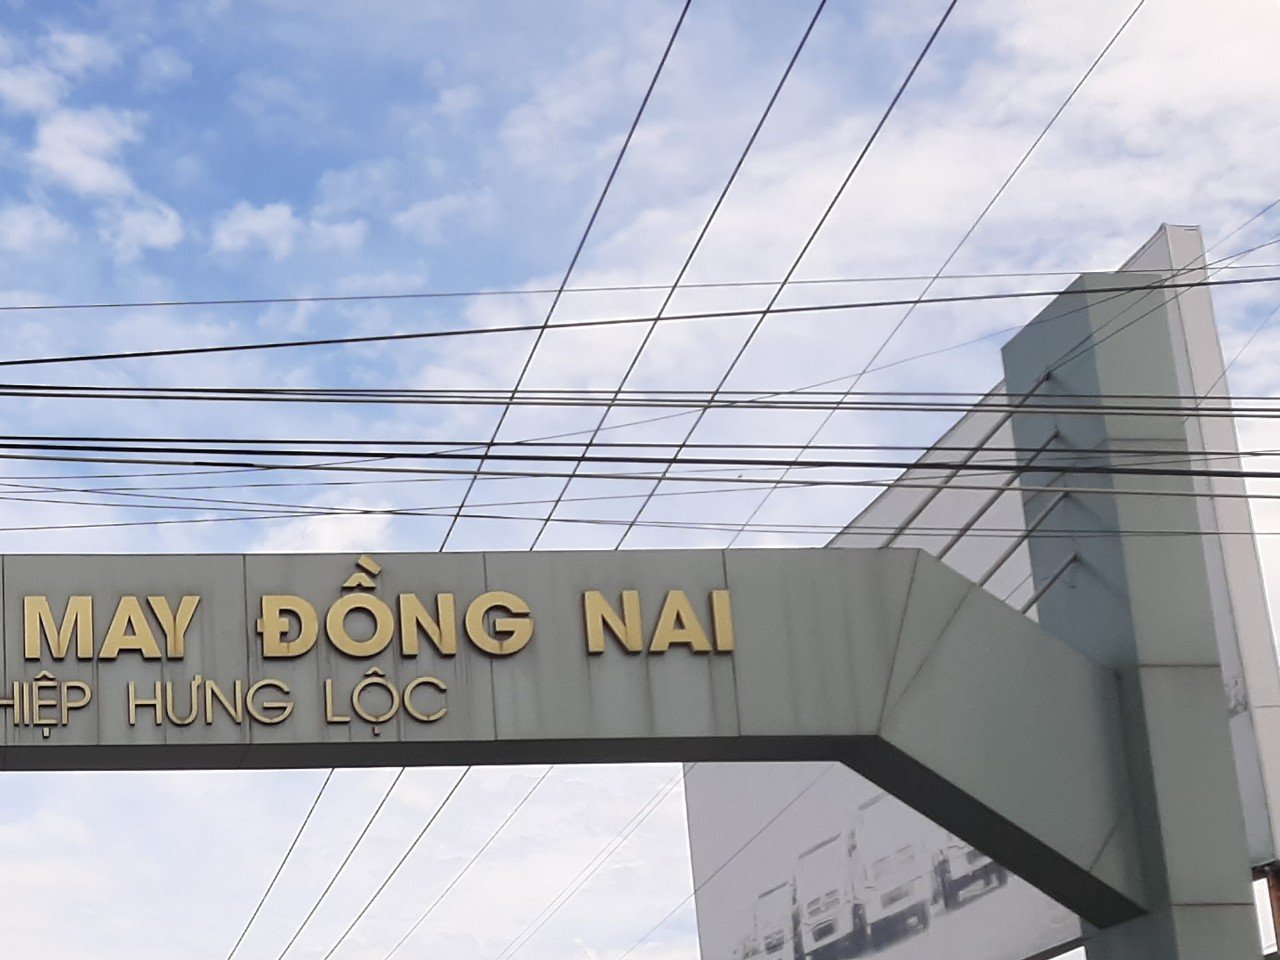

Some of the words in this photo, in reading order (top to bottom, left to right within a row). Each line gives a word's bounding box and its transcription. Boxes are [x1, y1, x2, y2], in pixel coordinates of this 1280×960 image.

[23, 595, 200, 660] MAY
[257, 554, 534, 658] ĐỒNG
[584, 589, 736, 655] NAI
[128, 673, 295, 726] HƯNG
[325, 666, 448, 736] LỘC
